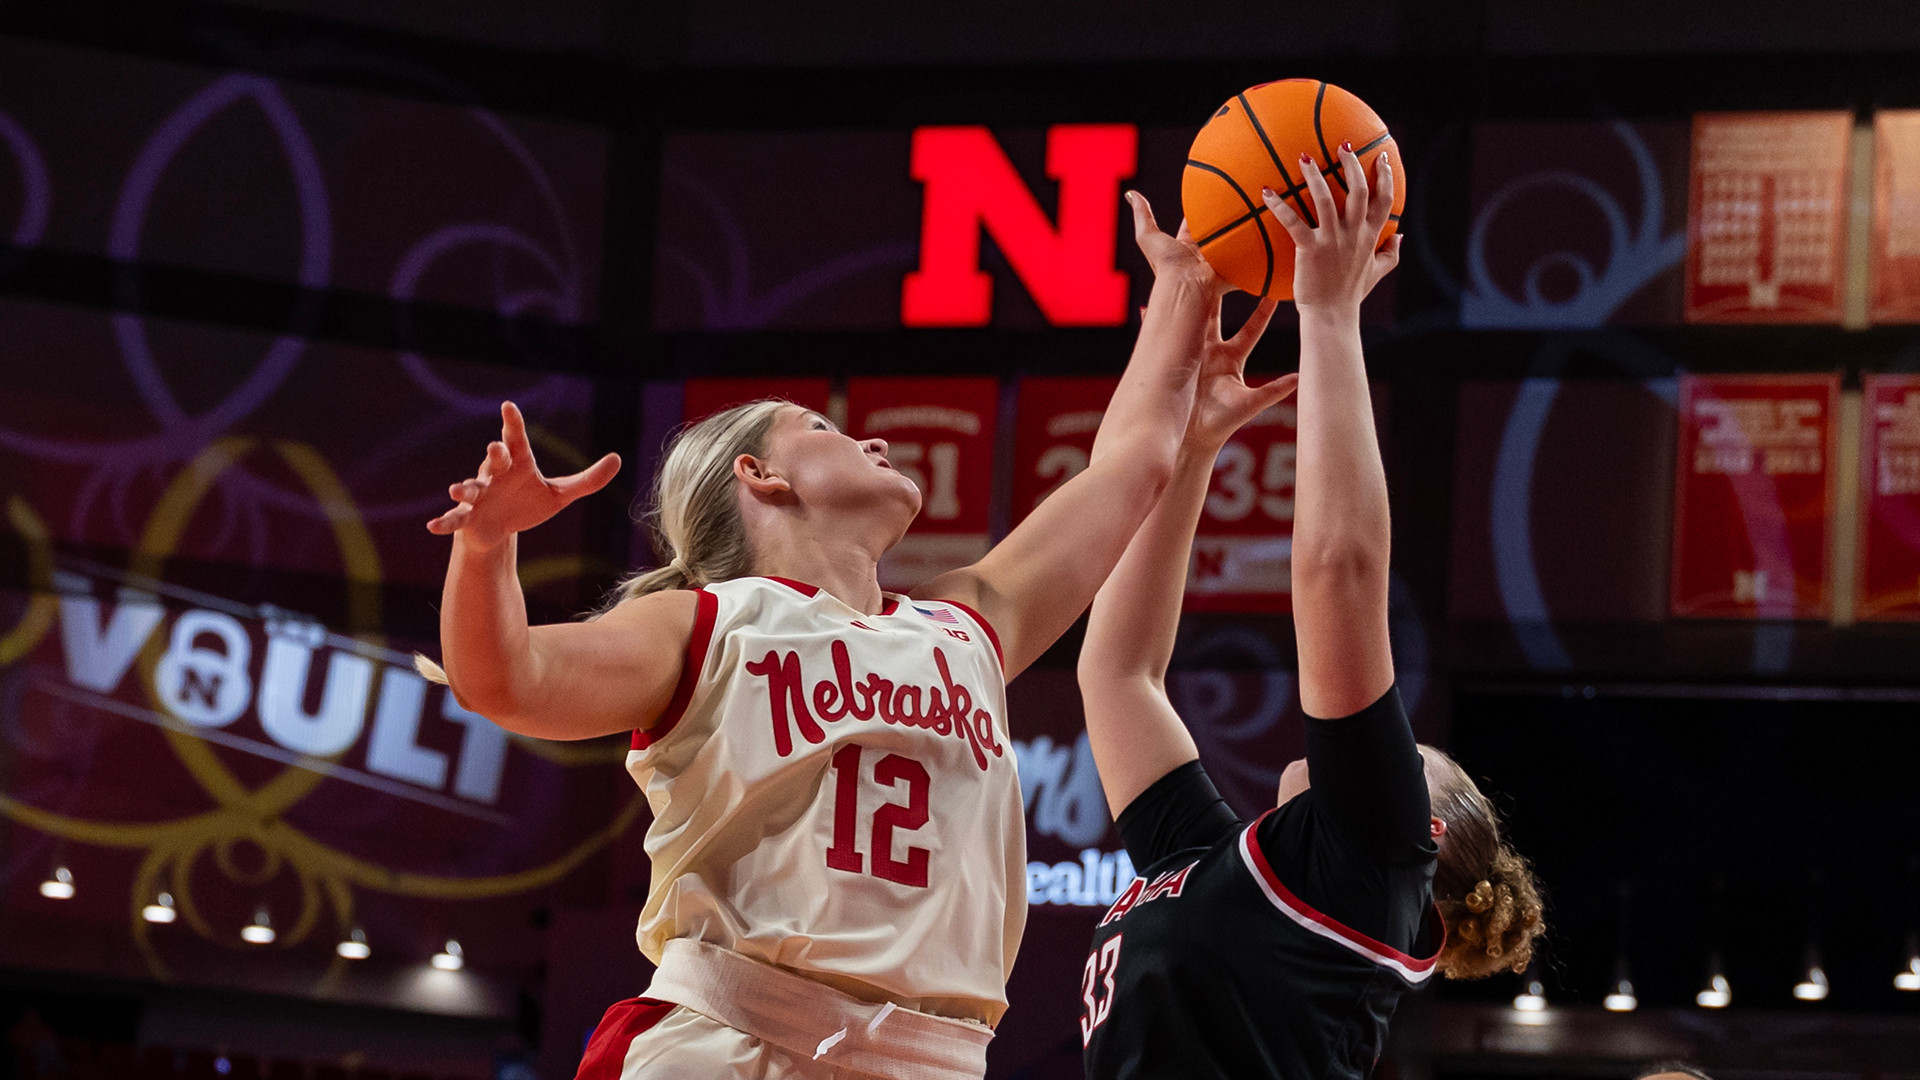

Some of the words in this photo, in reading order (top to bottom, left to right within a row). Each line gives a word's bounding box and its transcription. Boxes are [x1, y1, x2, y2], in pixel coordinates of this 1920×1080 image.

[901, 124, 1139, 327] N
[745, 639, 1003, 772] Nebraska
[826, 742, 931, 888] 12
[1080, 932, 1123, 1050] 33
